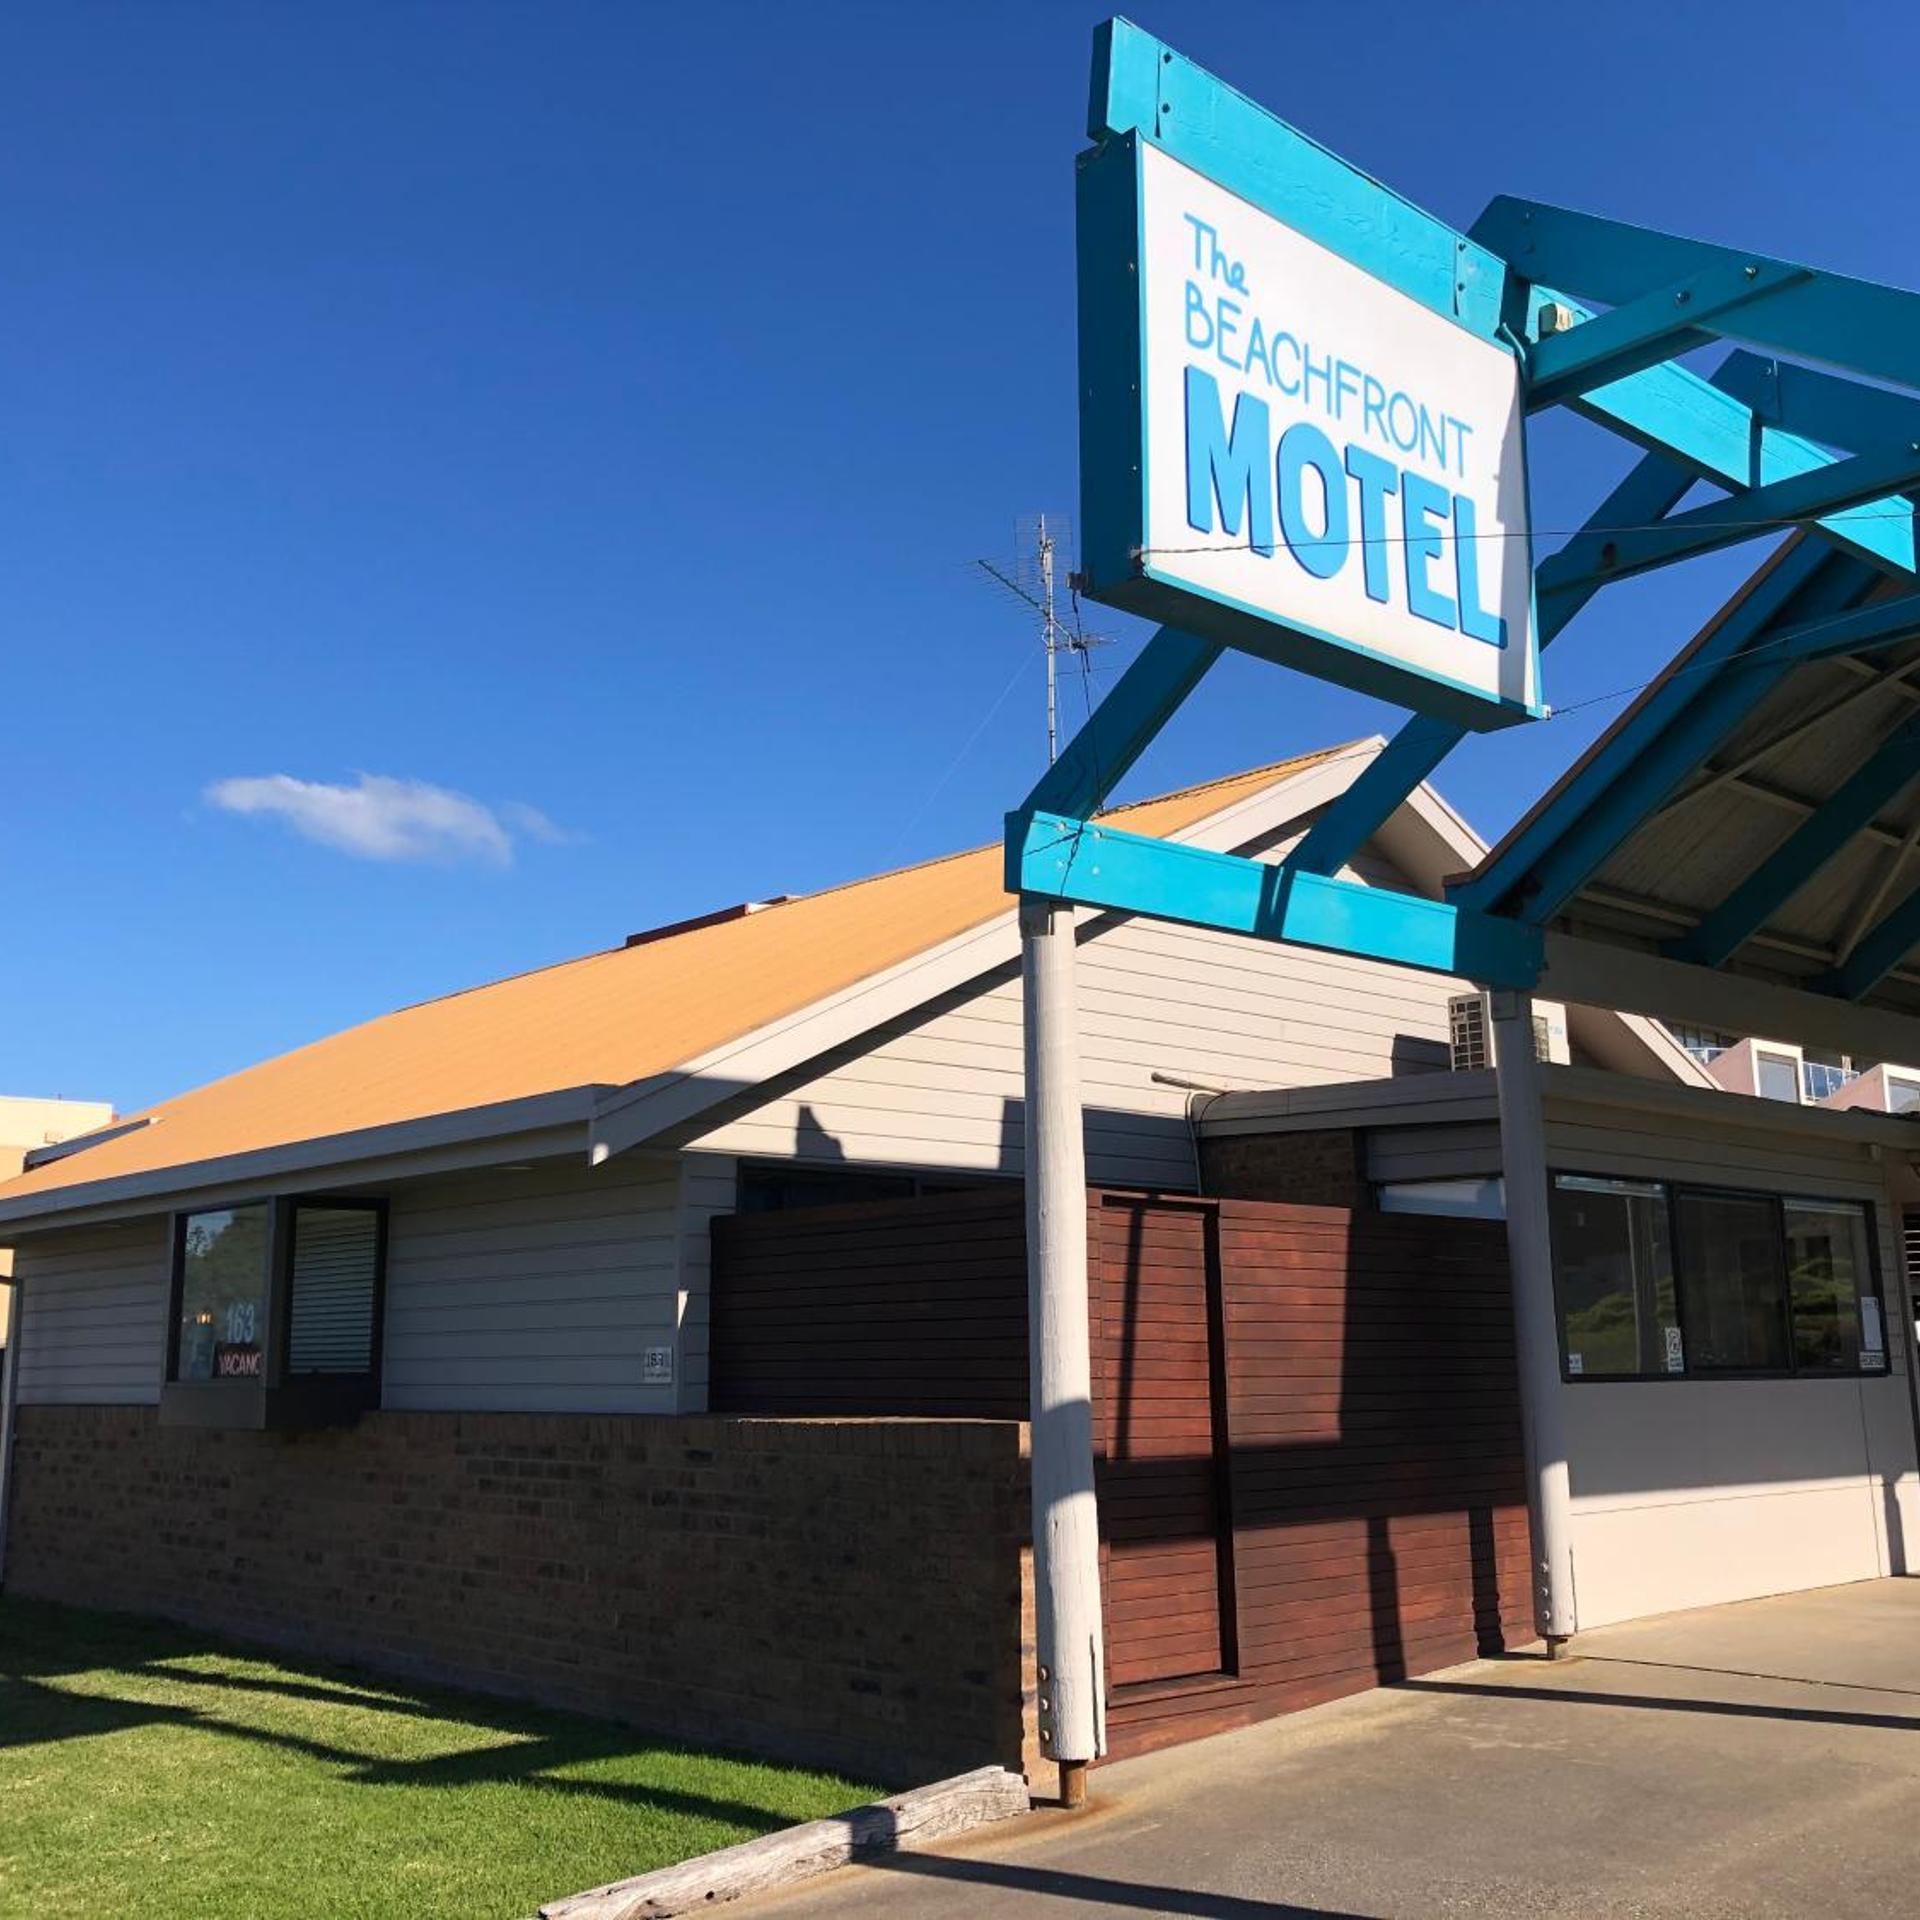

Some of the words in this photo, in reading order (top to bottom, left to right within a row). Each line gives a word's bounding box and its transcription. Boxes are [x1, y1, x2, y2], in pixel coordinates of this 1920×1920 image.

[1183, 212, 1250, 296] The
[1184, 280, 1473, 479] BEACHFRONT
[1184, 364, 1508, 650] MOTEL
[226, 1302, 255, 1344] 163
